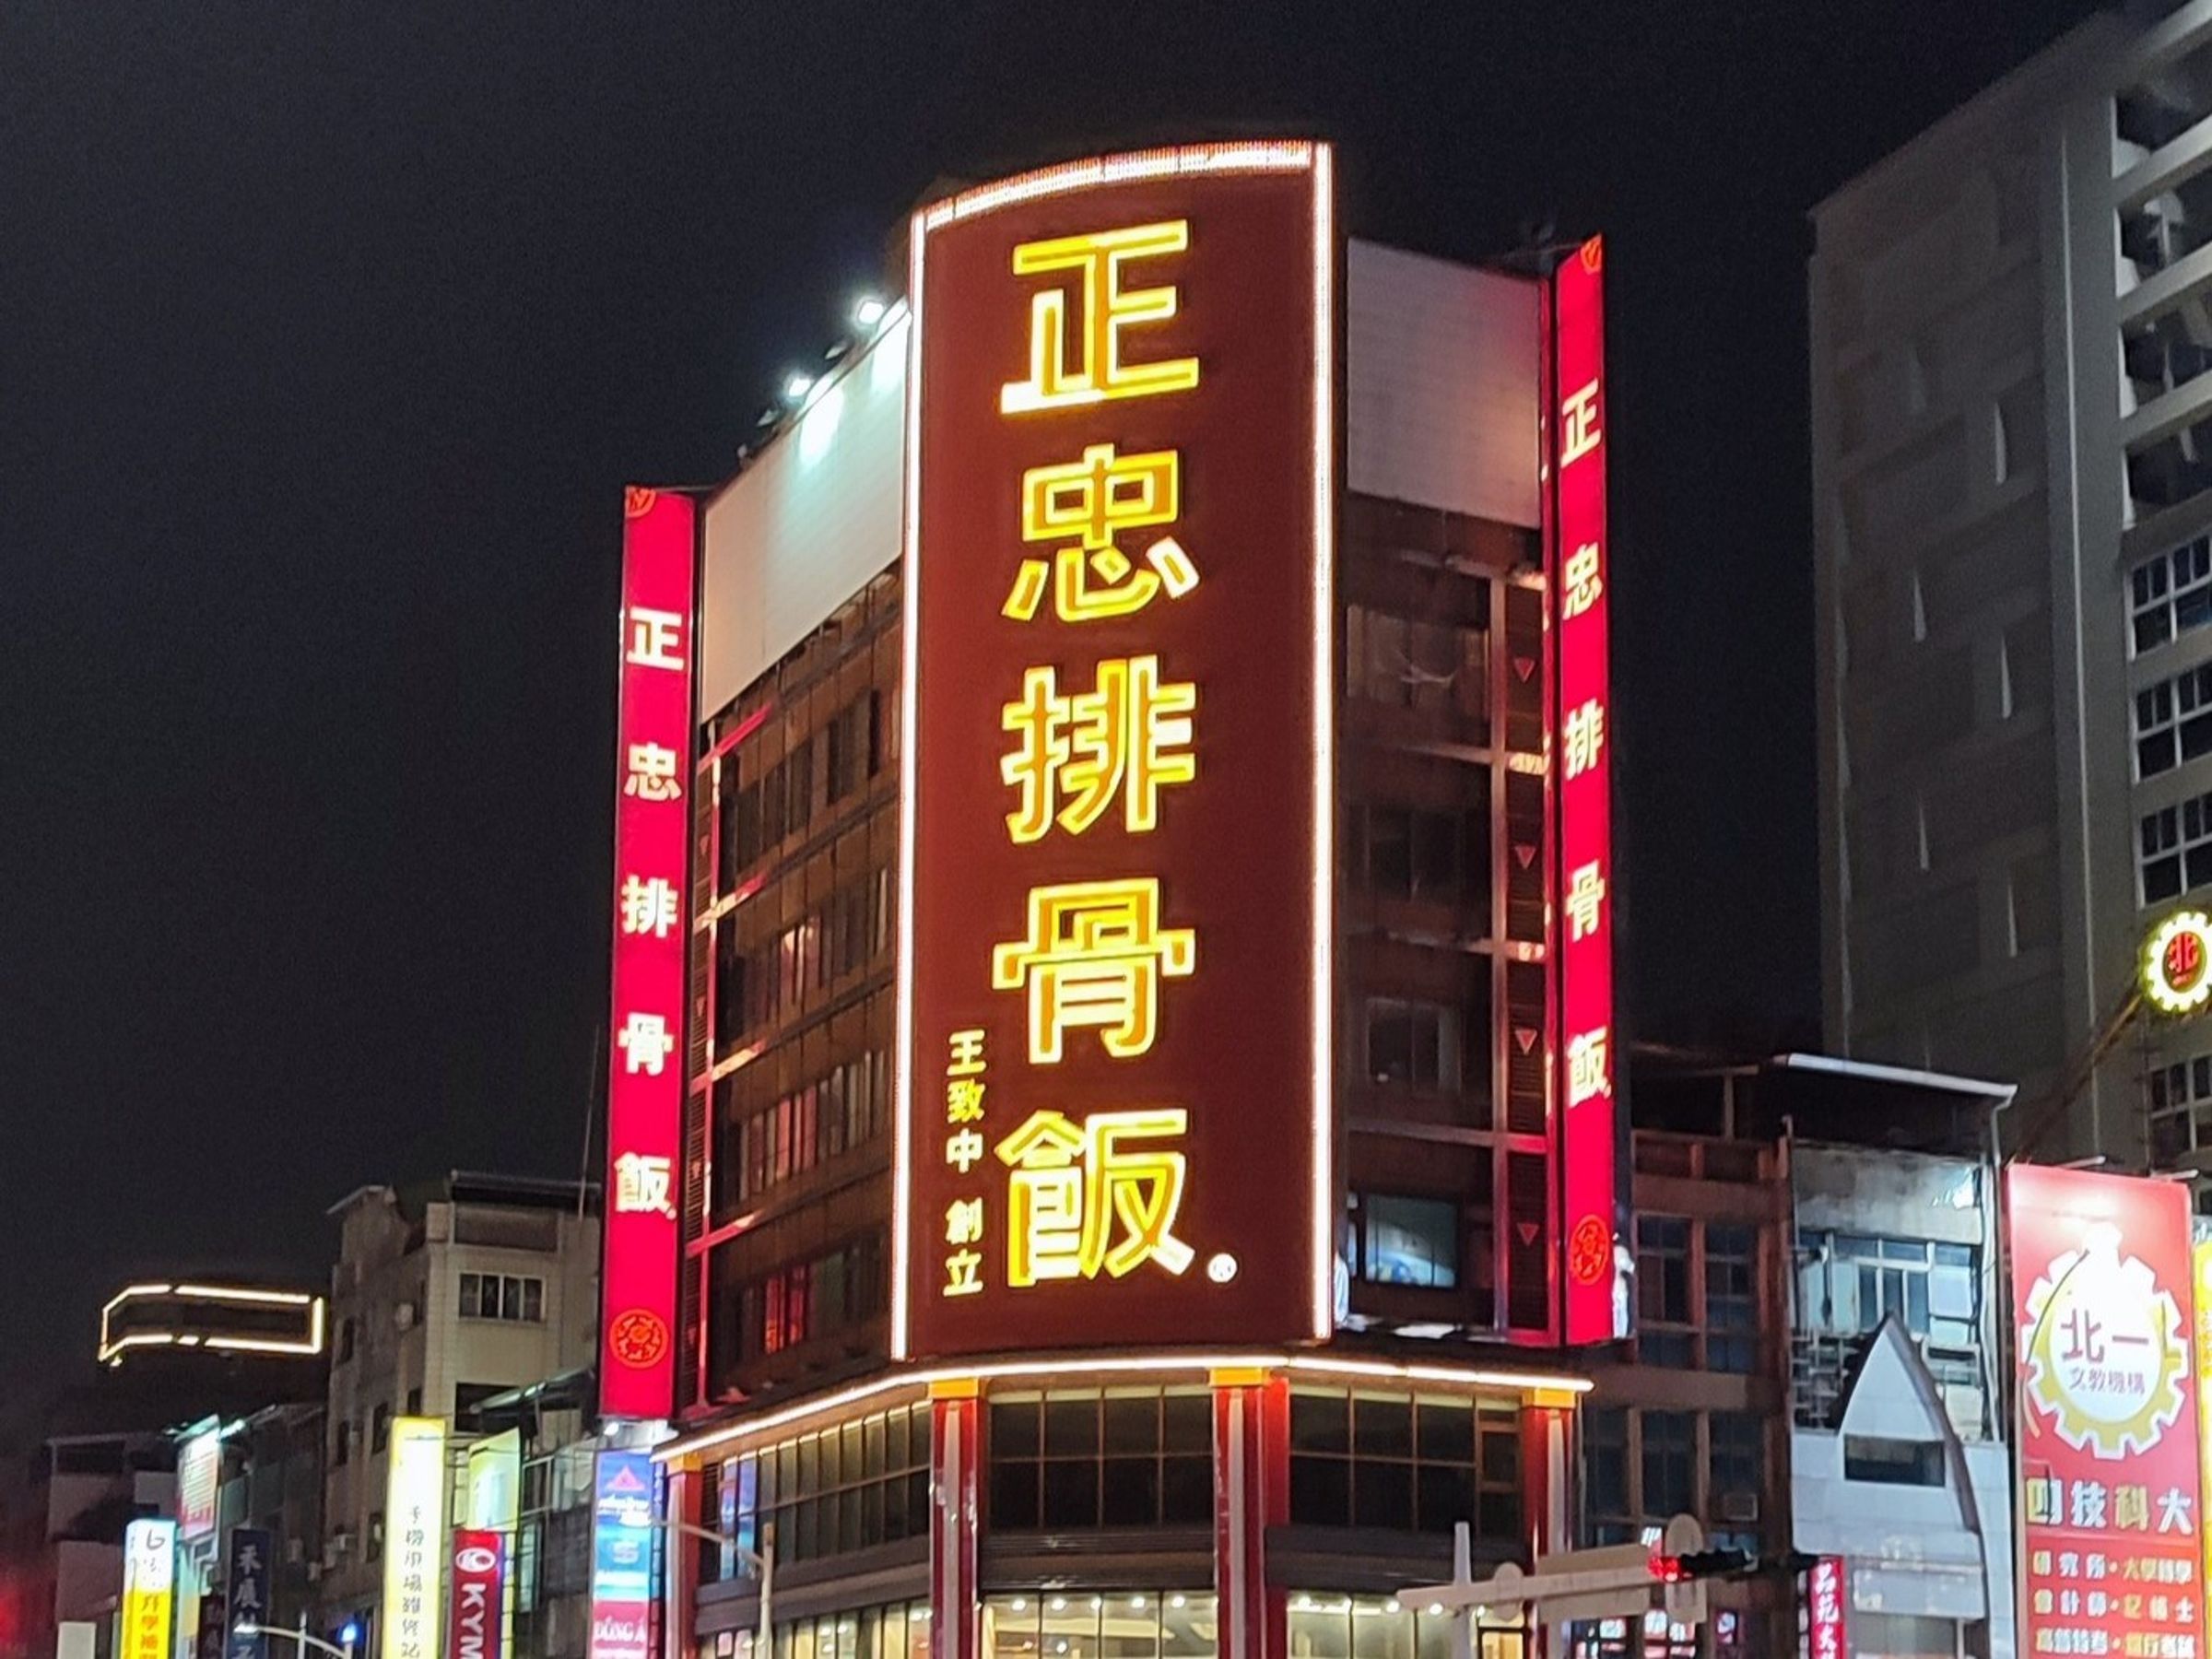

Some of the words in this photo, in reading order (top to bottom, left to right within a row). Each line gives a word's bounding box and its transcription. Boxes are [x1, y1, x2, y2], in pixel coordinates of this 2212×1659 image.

[992, 219, 1199, 1288] 正忠排骨飯
[1560, 376, 1607, 1109] 正忠排骨飯
[614, 606, 684, 1213] 正忠排骨飯
[946, 1029, 986, 1173] 王致中
[943, 1197, 983, 1296] 創立
[2060, 1308, 2149, 1364] 北一
[2027, 1477, 2194, 1535] 四技科大
